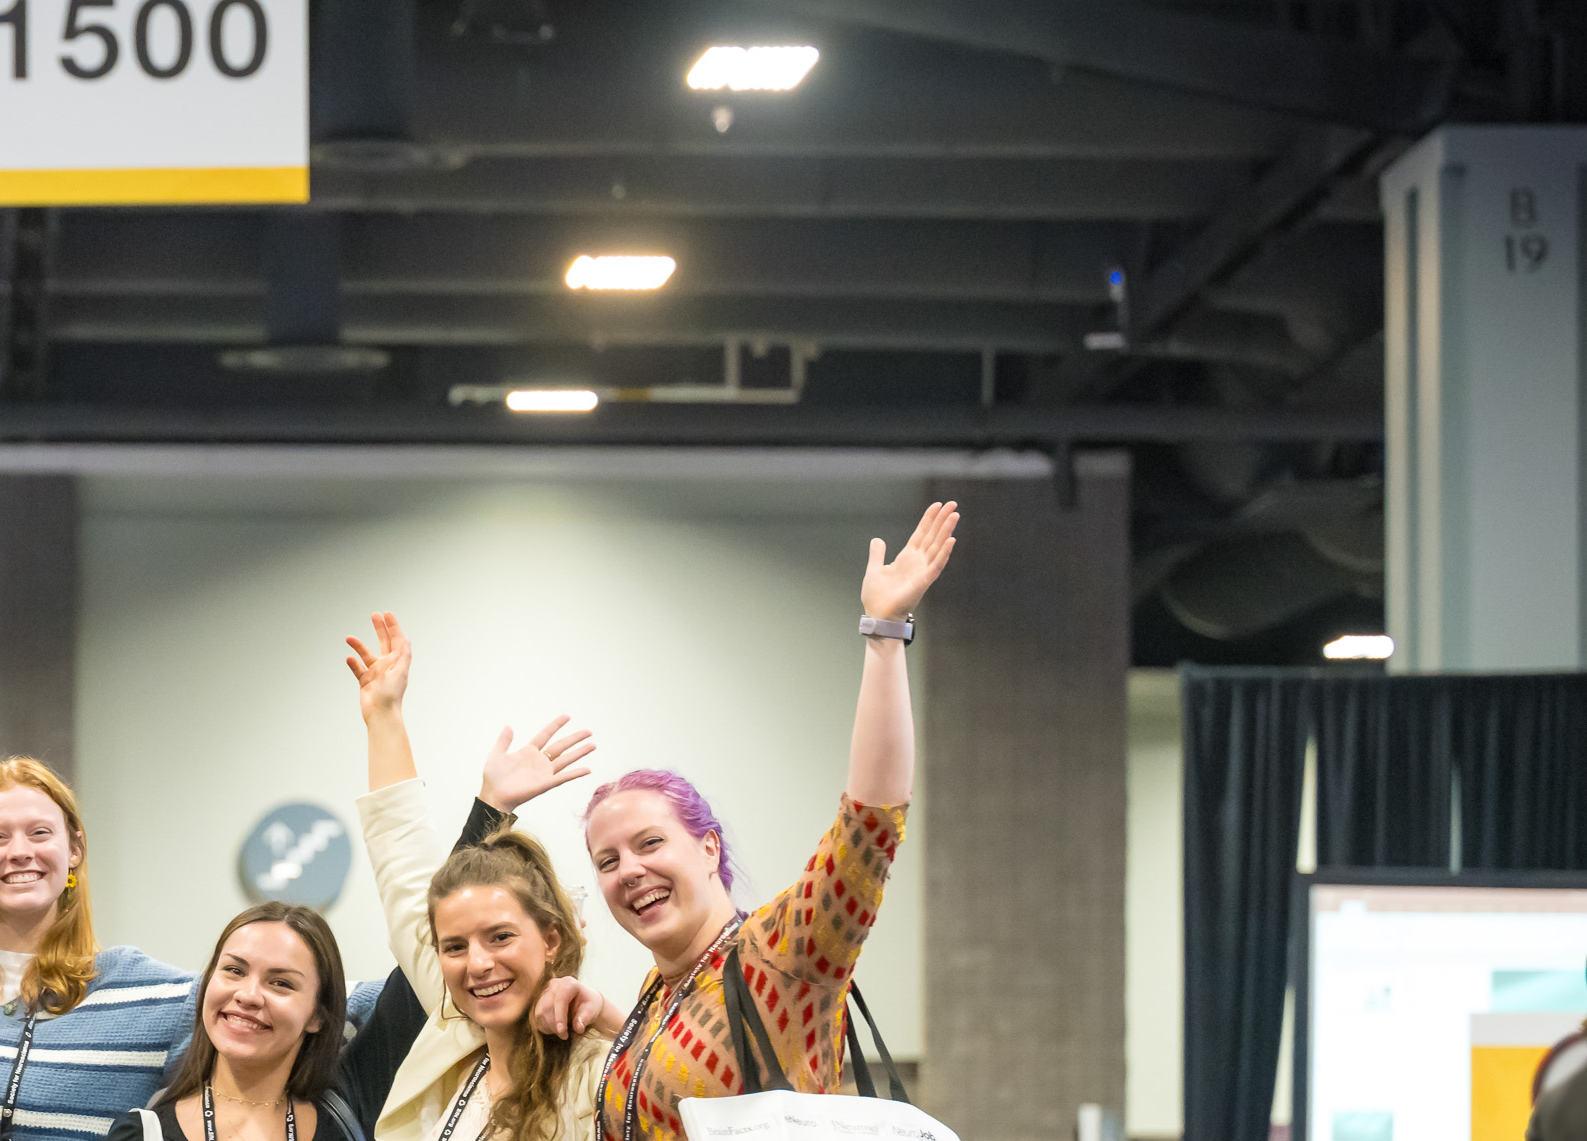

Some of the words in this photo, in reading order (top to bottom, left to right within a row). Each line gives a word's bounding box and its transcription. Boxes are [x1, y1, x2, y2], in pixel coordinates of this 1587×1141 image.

[1505, 232, 1548, 274] 19
[619, 1018, 638, 1043] Society
[613, 1042, 624, 1053] for
[7, 1082, 19, 1105] Society
[14, 1040, 30, 1075] Neuroscience
[462, 1065, 486, 1098] Neuroscience
